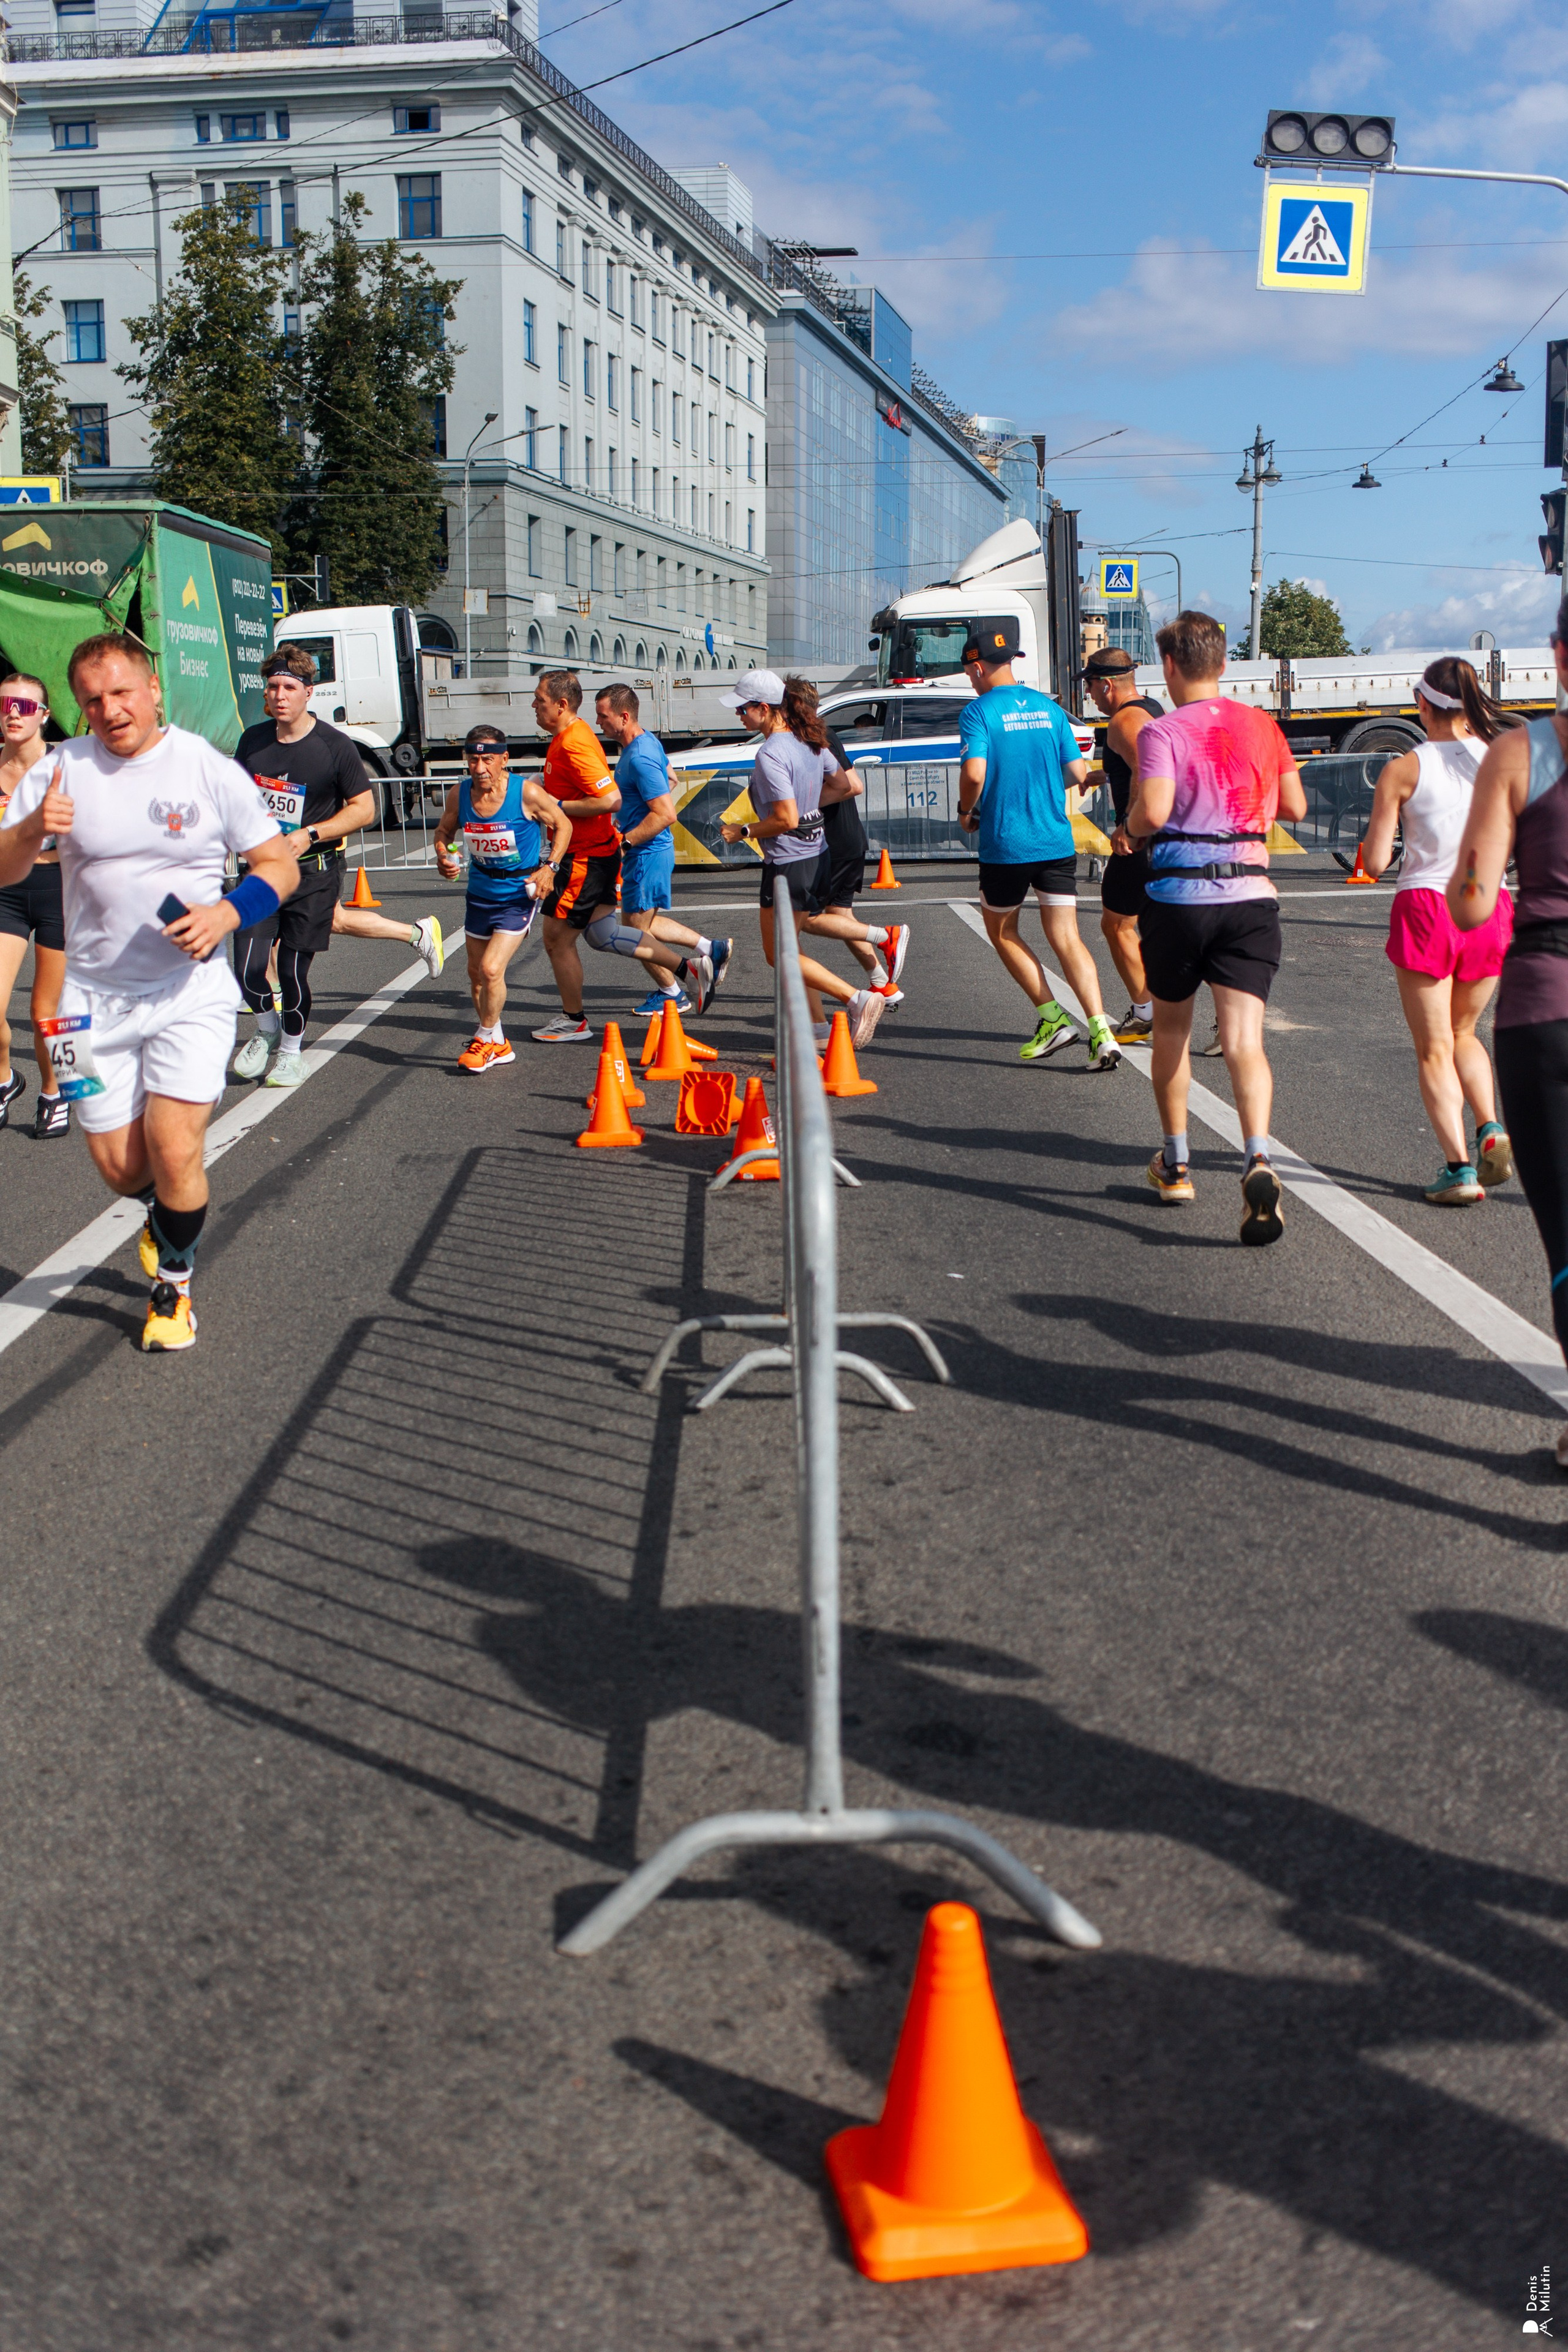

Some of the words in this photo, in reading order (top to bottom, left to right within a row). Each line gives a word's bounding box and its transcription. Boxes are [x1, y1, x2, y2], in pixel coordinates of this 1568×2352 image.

[0, 559, 108, 576] овичкоф
[167, 619, 218, 647] грузовичкоф
[235, 613, 268, 640] Перевезём
[237, 646, 246, 661] на
[246, 644, 265, 663] новый
[179, 651, 209, 677] Бизнес
[238, 673, 264, 693] уровень
[1002, 711, 1049, 722] САНКТ-ПЕТЕРБУРГ
[1004, 722, 1028, 732] БЕГОВАЯ
[1029, 720, 1052, 729] СТОЛИЦА
[262, 792, 296, 814] 650
[908, 791, 938, 807] 112
[472, 839, 510, 853] 7258
[51, 1041, 75, 1067] 45
